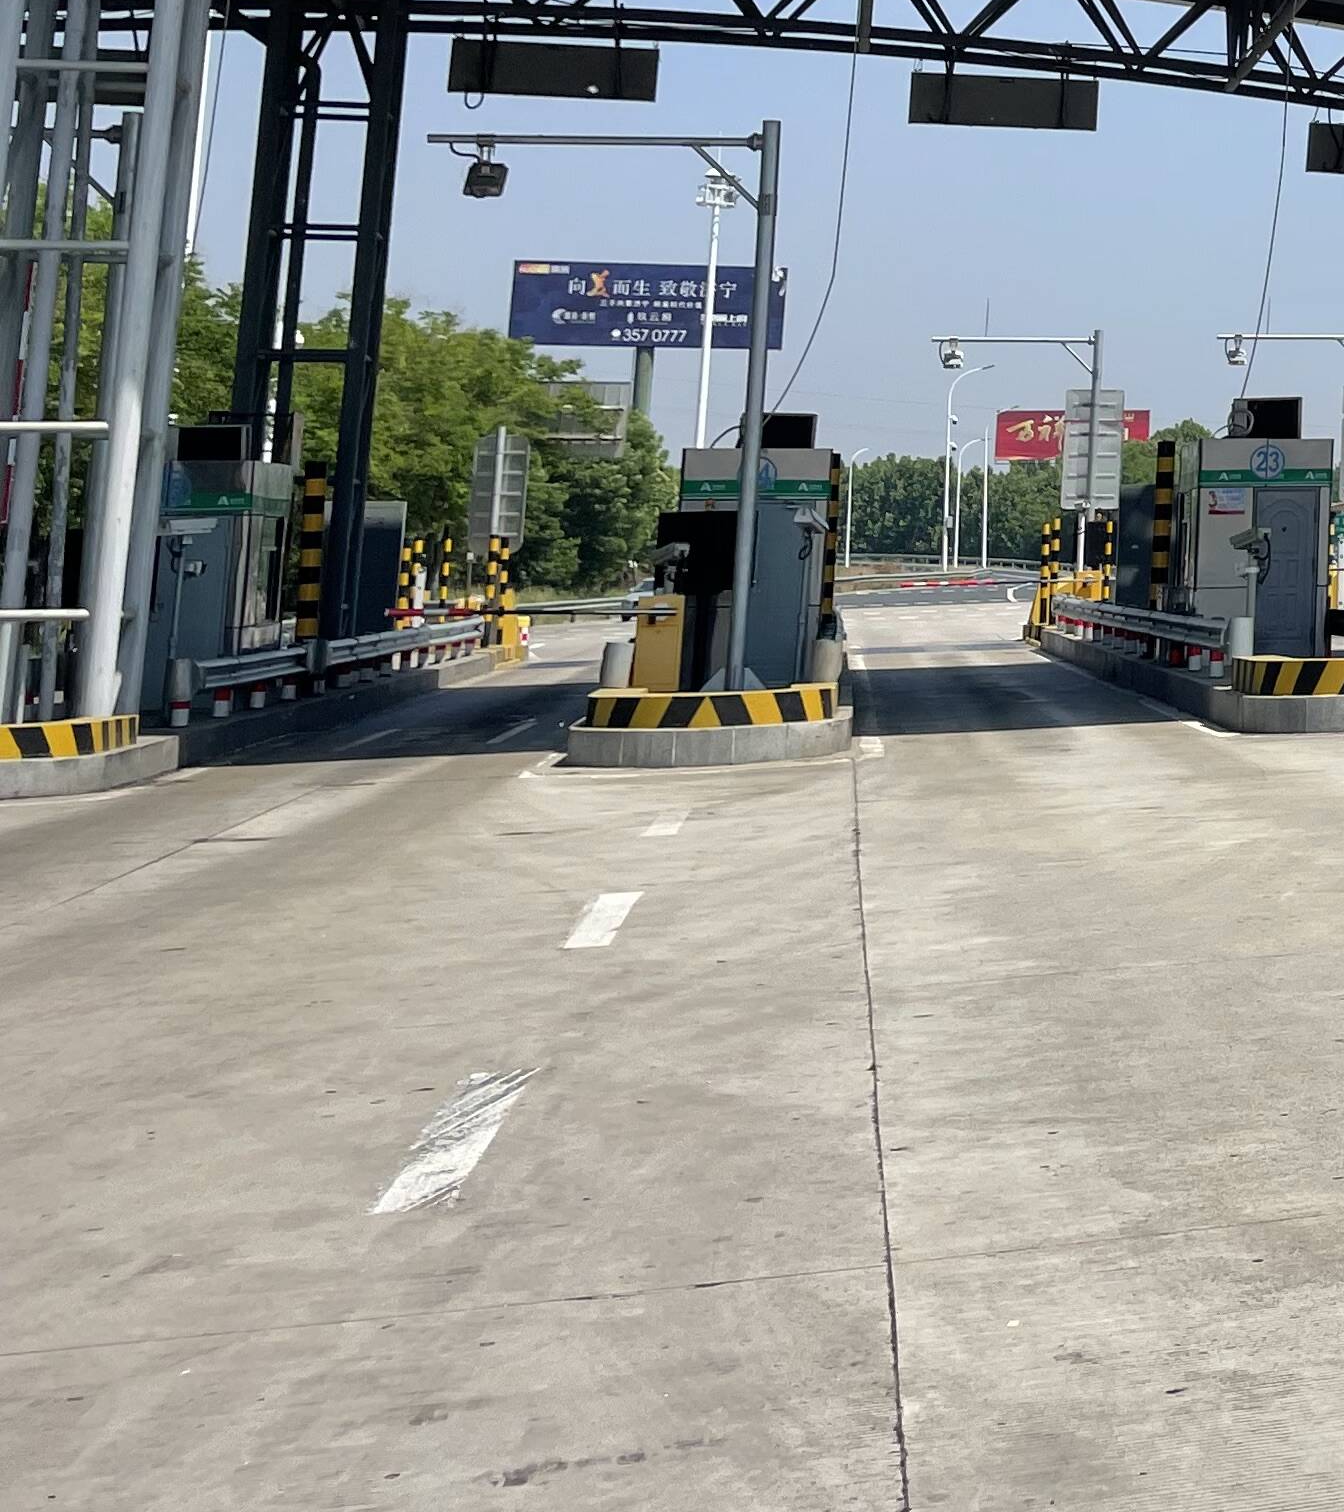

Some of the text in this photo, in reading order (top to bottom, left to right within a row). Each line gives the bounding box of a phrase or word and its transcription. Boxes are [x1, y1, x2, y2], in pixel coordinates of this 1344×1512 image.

[659, 279, 737, 299] 致敬宁
[1255, 450, 1280, 472] 23
